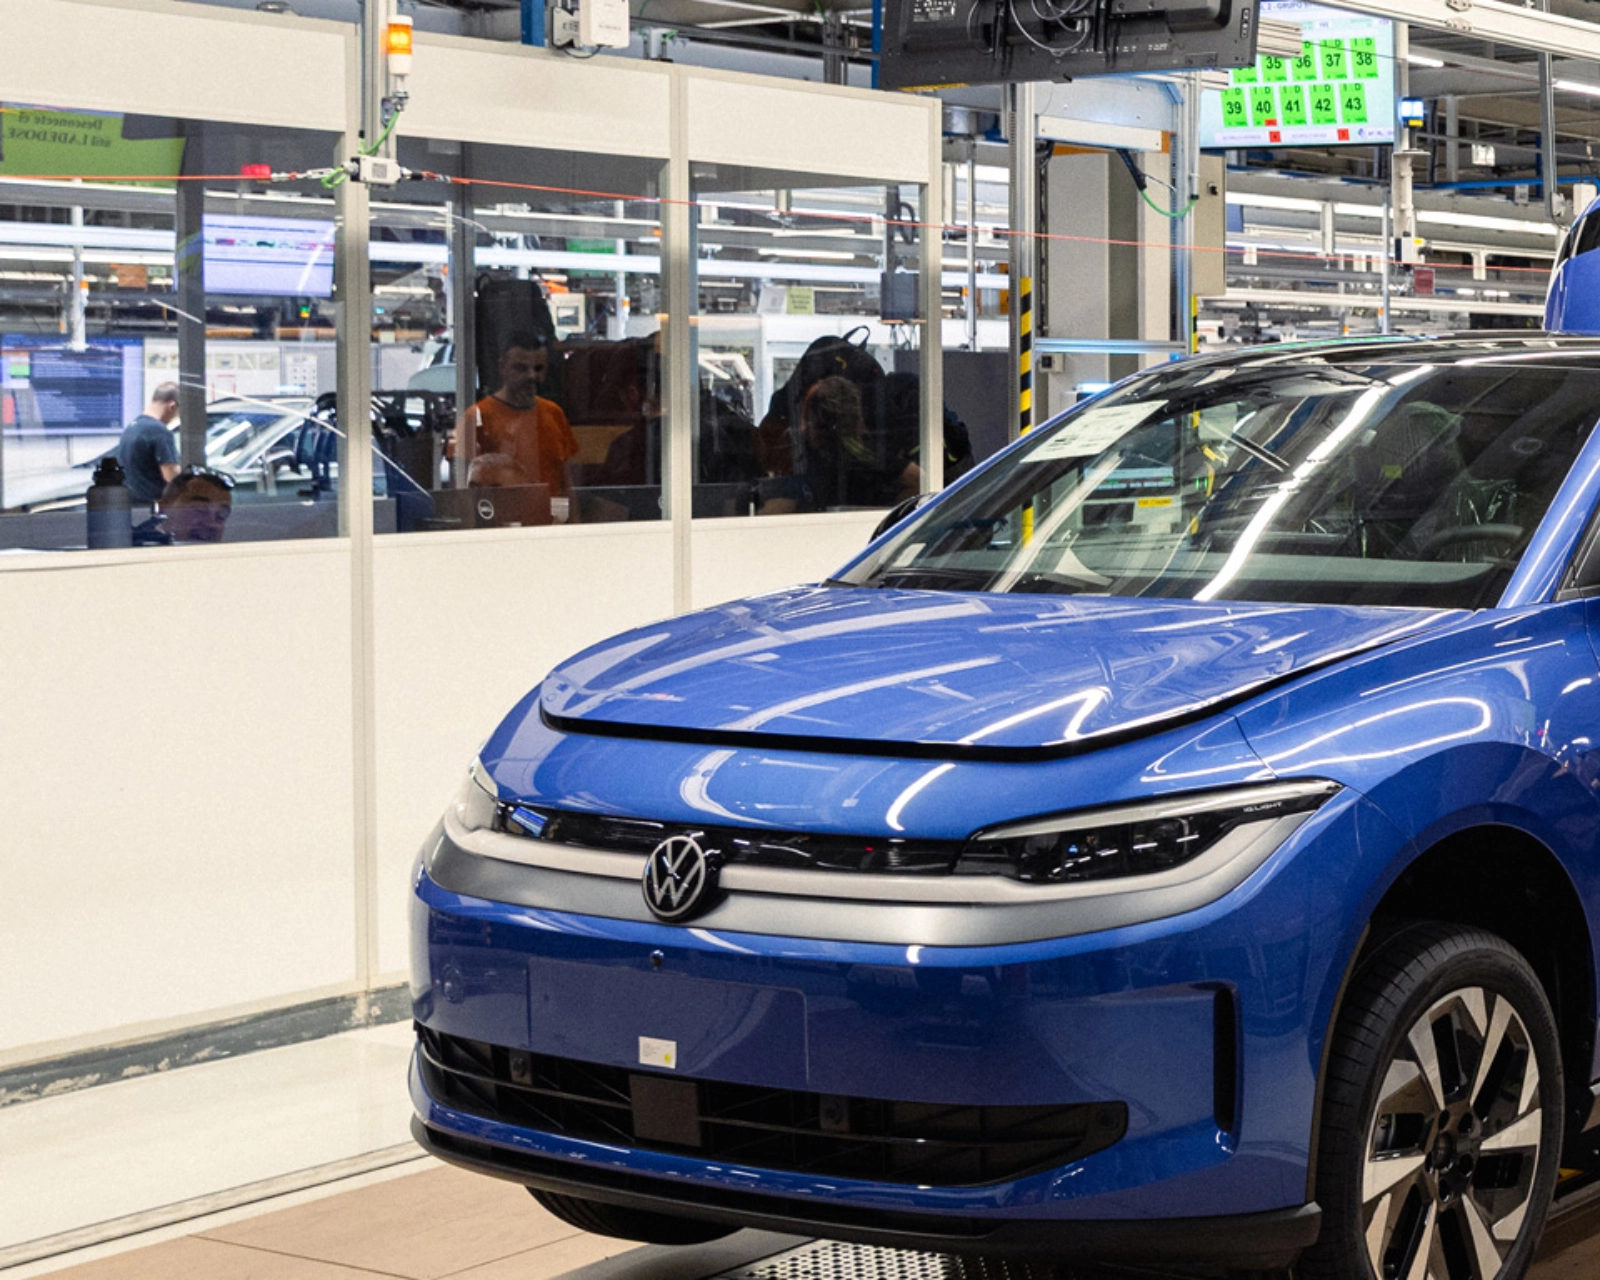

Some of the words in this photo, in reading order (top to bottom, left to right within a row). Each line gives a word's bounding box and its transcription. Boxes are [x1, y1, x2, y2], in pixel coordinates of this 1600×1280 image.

[1266, 56, 1282, 70] 35
[1296, 54, 1312, 69] 36
[1325, 53, 1341, 67] 37
[1356, 51, 1372, 66] 38
[1226, 101, 1242, 114] 39
[1256, 100, 1271, 114] 40
[1285, 99, 1300, 113] 41
[1315, 98, 1332, 112] 42
[1345, 97, 1362, 111] 43
